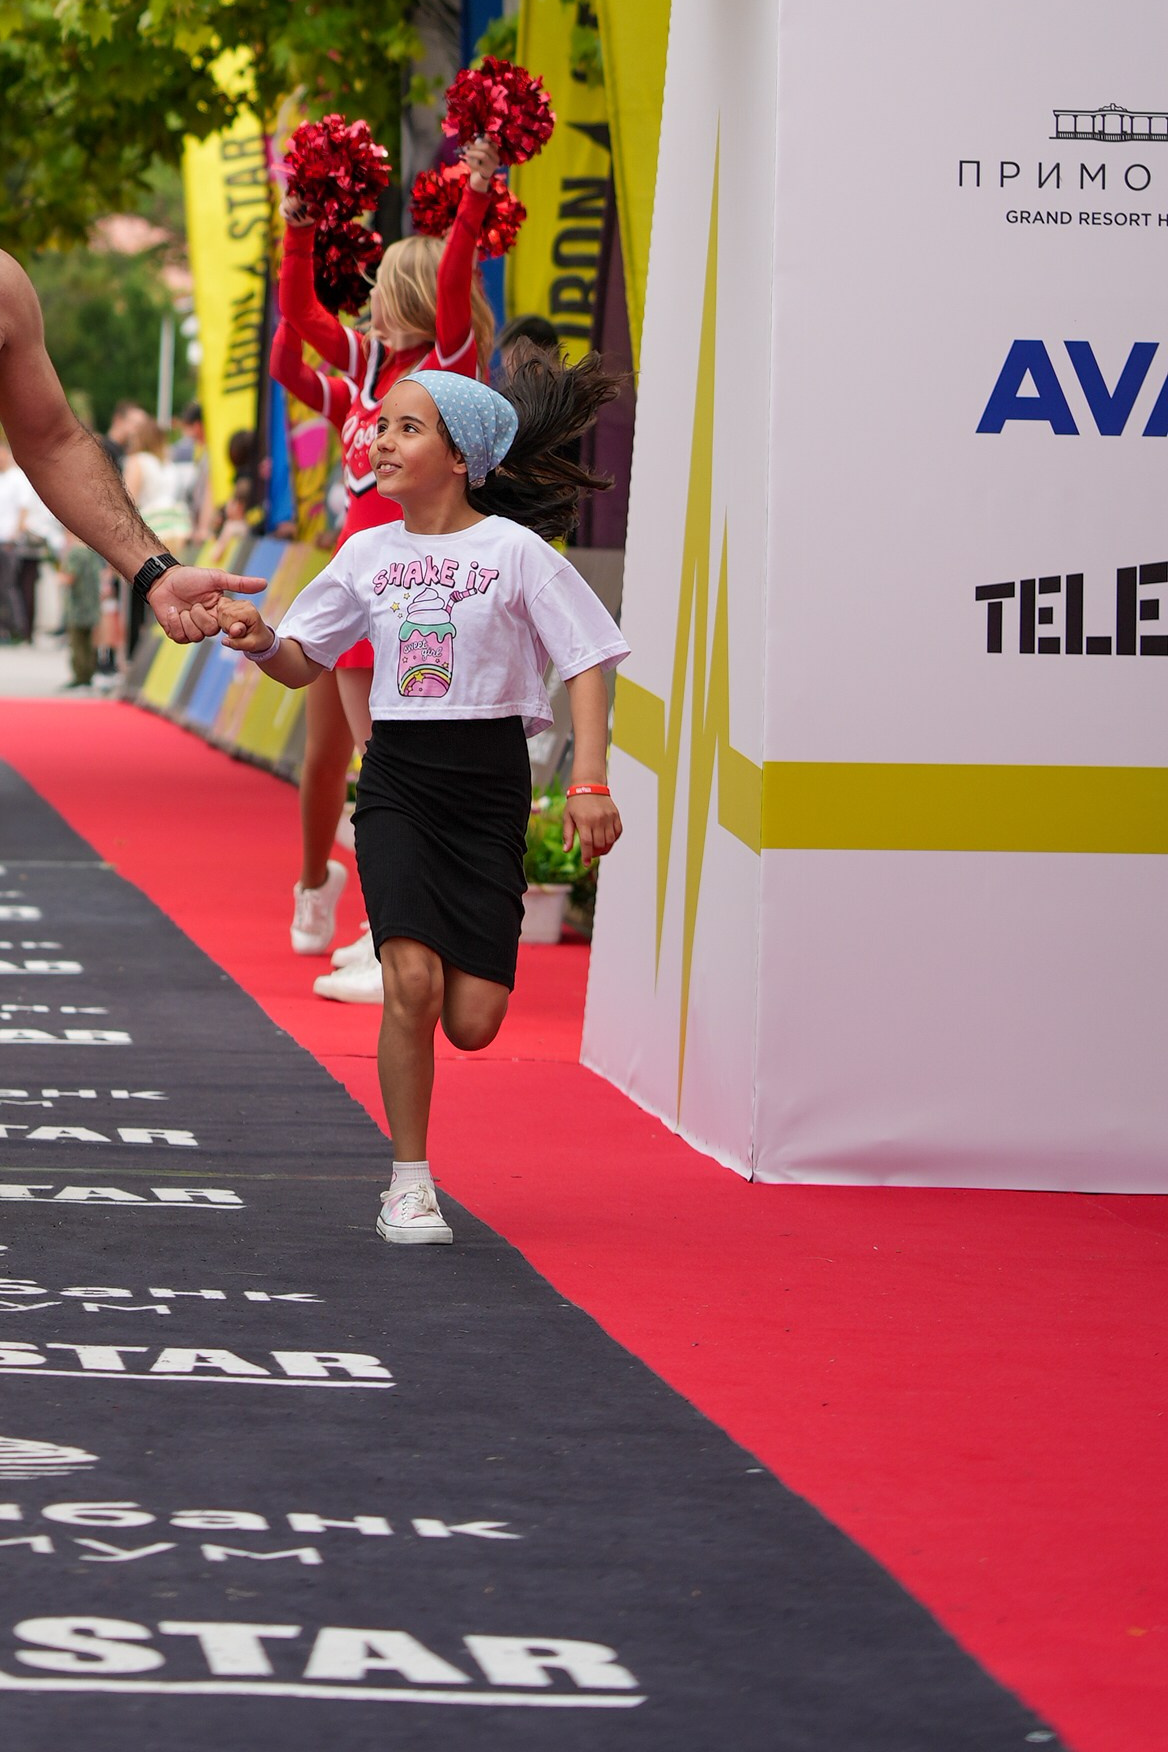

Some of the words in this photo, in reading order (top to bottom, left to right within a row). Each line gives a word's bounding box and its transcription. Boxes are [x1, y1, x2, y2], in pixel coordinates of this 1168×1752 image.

[959, 160, 1152, 192] ПРИМО
[1006, 210, 1073, 225] GRAND
[1079, 211, 1152, 227] RESORT
[547, 175, 609, 340] IRON
[975, 339, 1168, 437] AV
[975, 561, 1168, 657] TELE
[421, 647, 444, 662] girl
[13, 1616, 641, 1690] STAR
